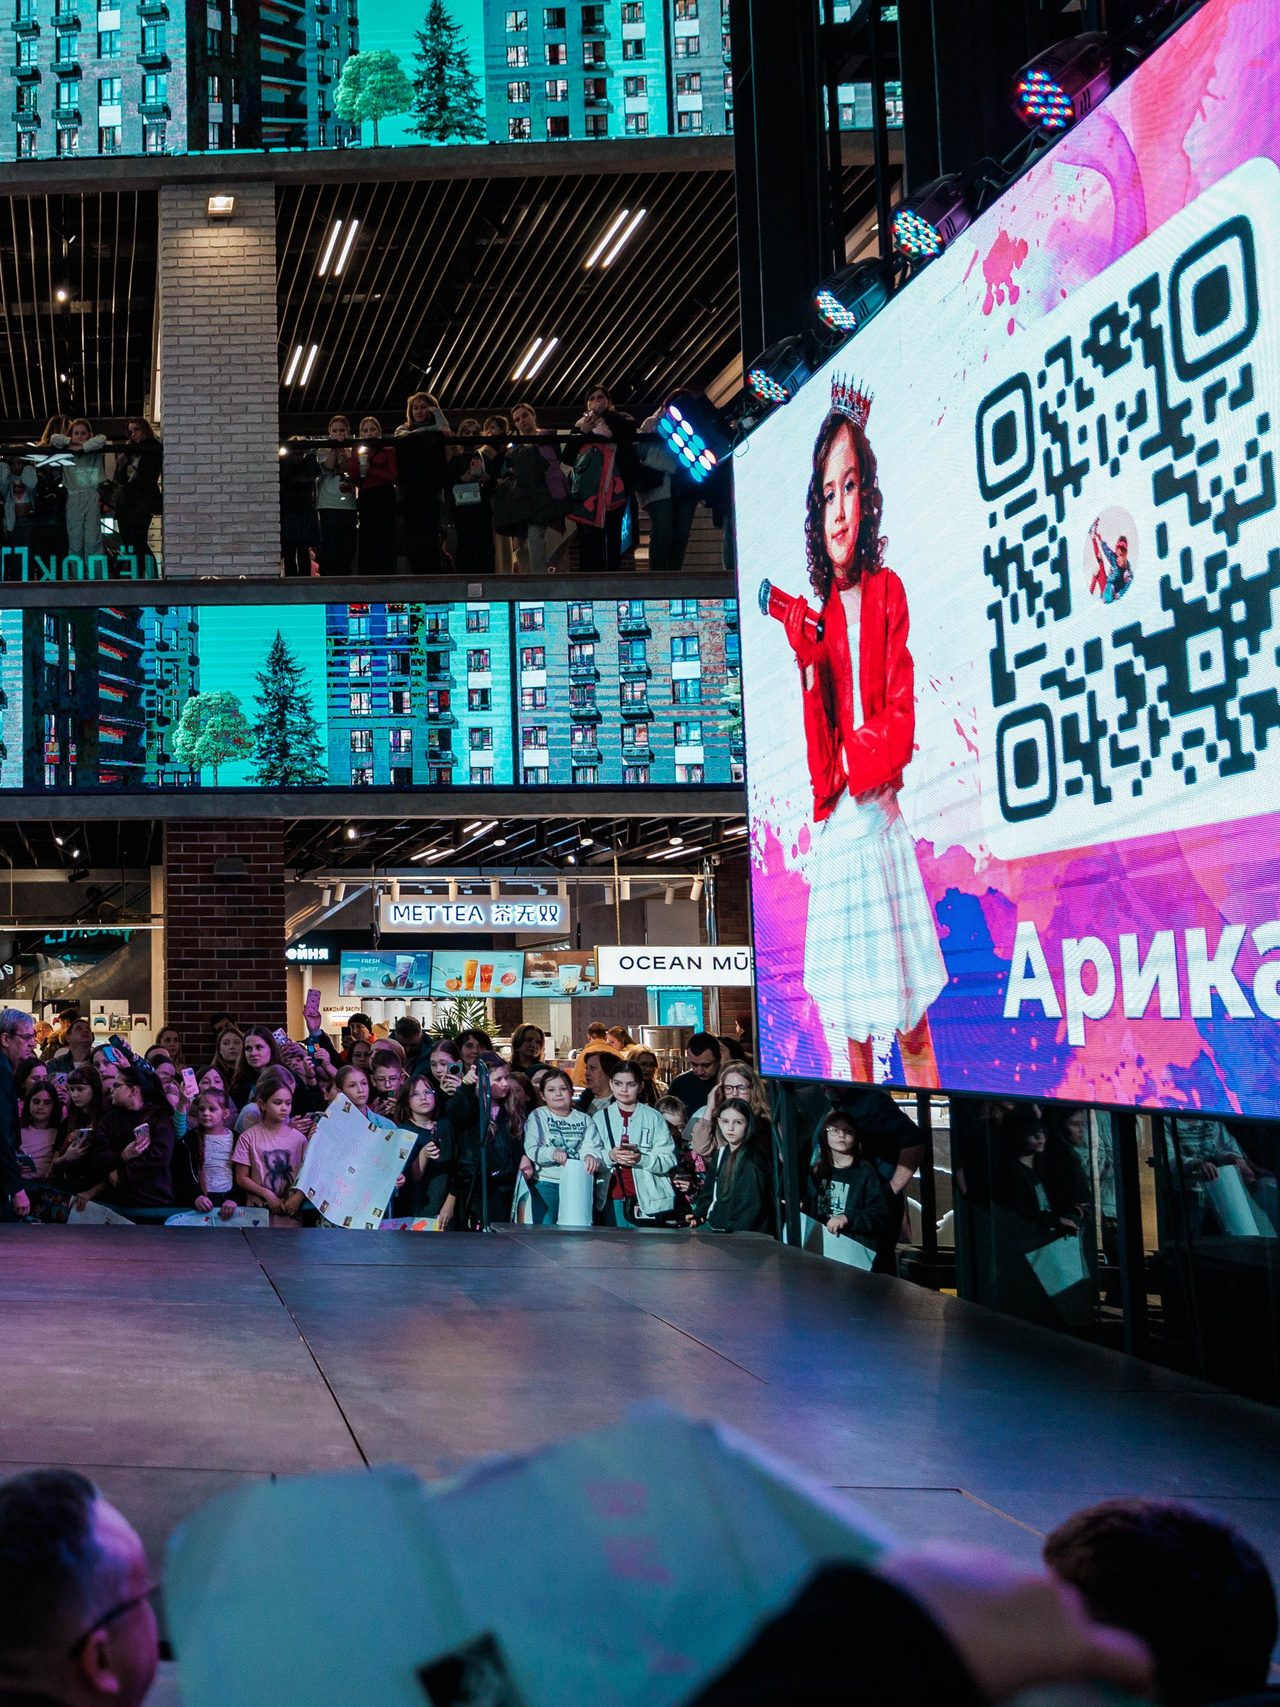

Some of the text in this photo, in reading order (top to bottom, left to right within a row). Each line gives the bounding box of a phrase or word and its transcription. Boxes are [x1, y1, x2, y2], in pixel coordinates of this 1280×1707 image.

[393, 905, 436, 921] MET
[442, 905, 483, 921] TEA
[619, 956, 702, 970] OCEAN
